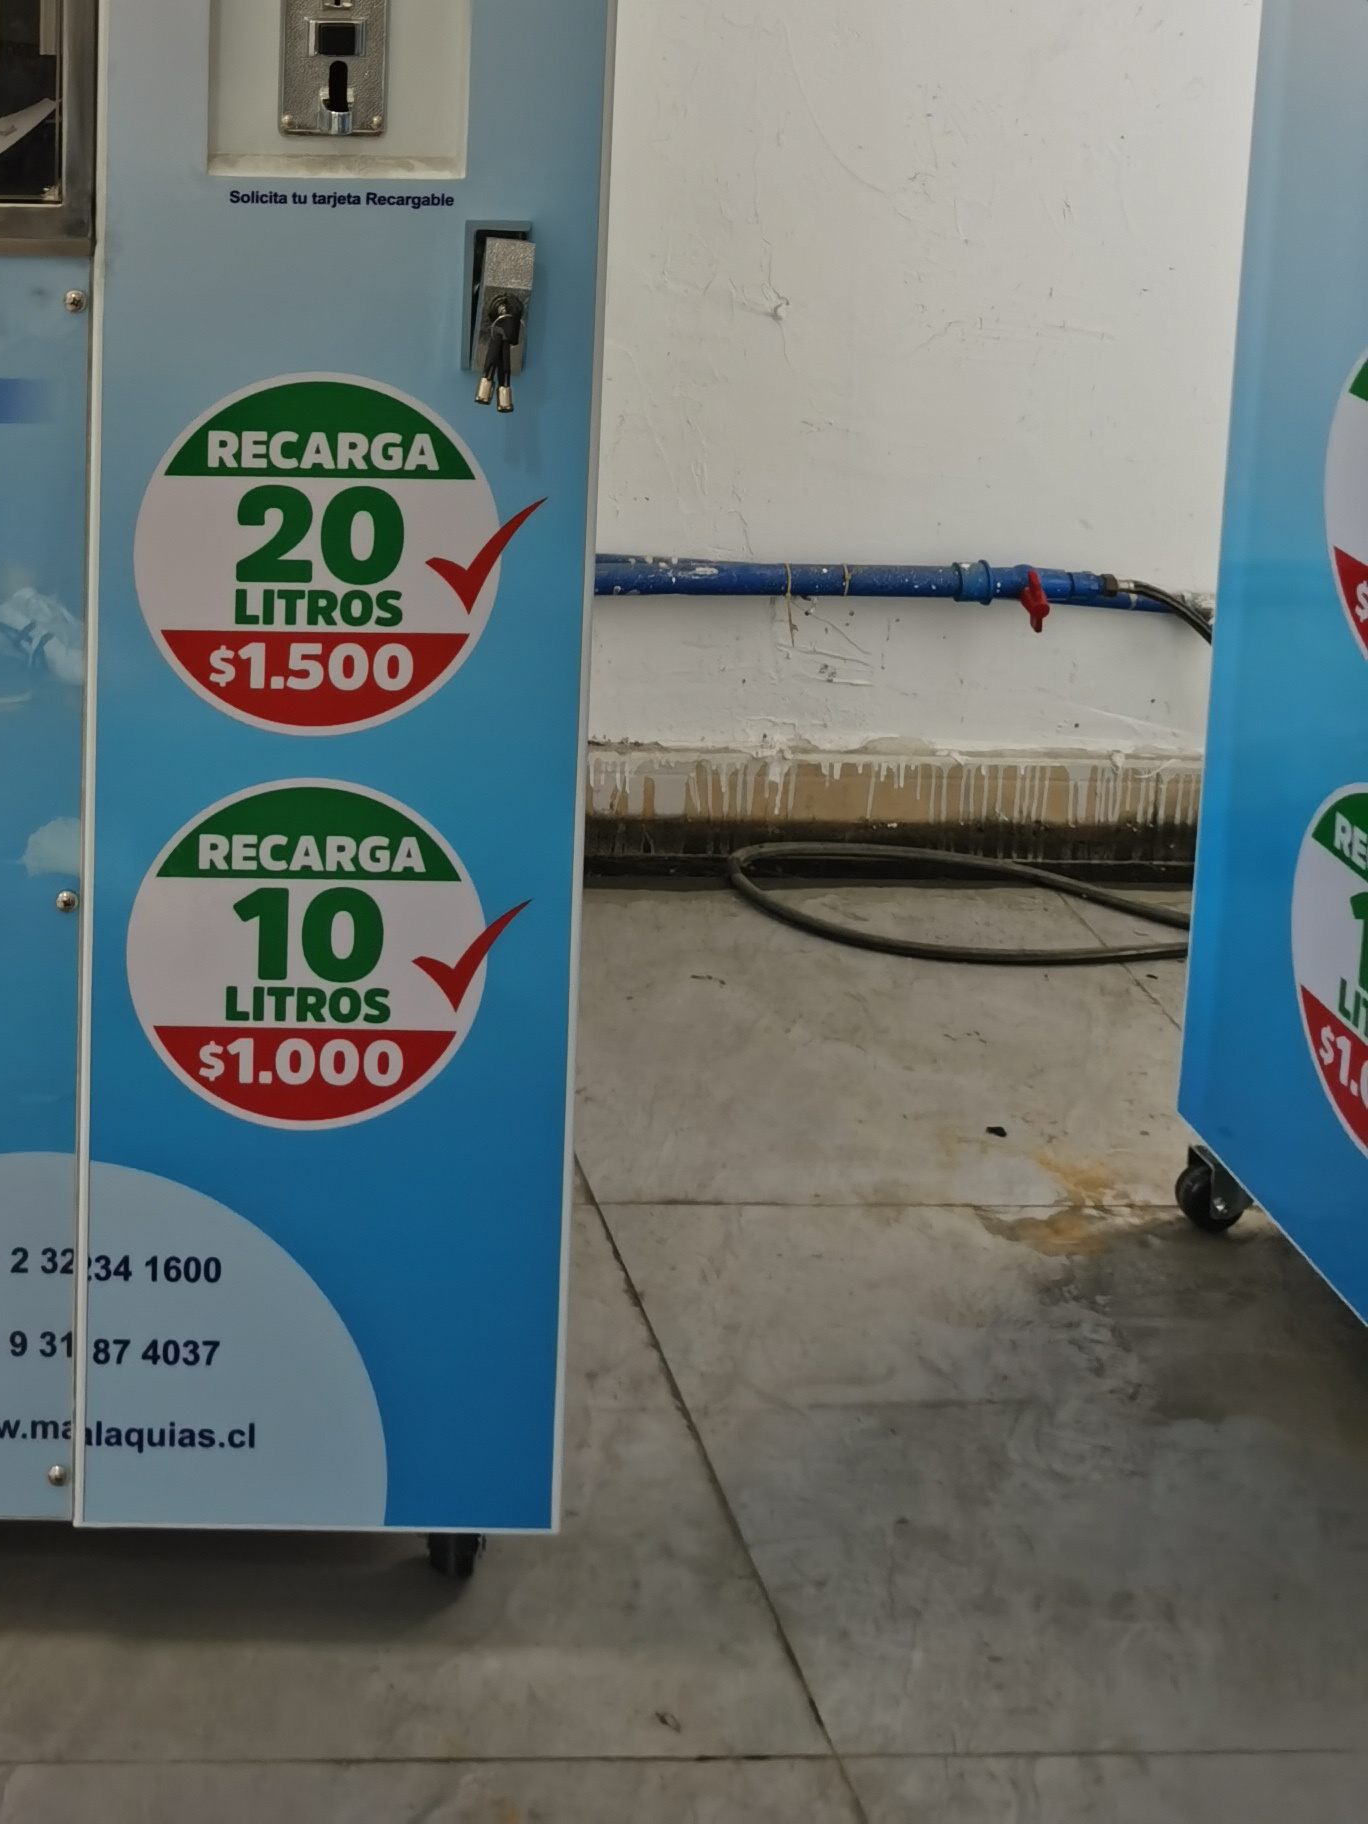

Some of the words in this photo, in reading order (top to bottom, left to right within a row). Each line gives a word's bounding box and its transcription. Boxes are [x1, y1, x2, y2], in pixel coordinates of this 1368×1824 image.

[230, 190, 287, 204] Solicita
[292, 192, 307, 204] tu
[312, 192, 361, 208] tarjeta
[366, 192, 454, 209] Recargable
[208, 429, 440, 472] RECARGA
[235, 485, 405, 585] 20
[234, 588, 403, 627] LITROS
[208, 642, 414, 691] $1.500
[198, 833, 426, 874] RECARGA
[232, 886, 384, 984] 10
[225, 985, 391, 1024] LITROS
[198, 1037, 404, 1088] $1.000
[11, 1247, 28, 1274] 2
[145, 1256, 222, 1283] 1600
[9, 1330, 27, 1356] 9
[142, 1339, 220, 1365] 4037
